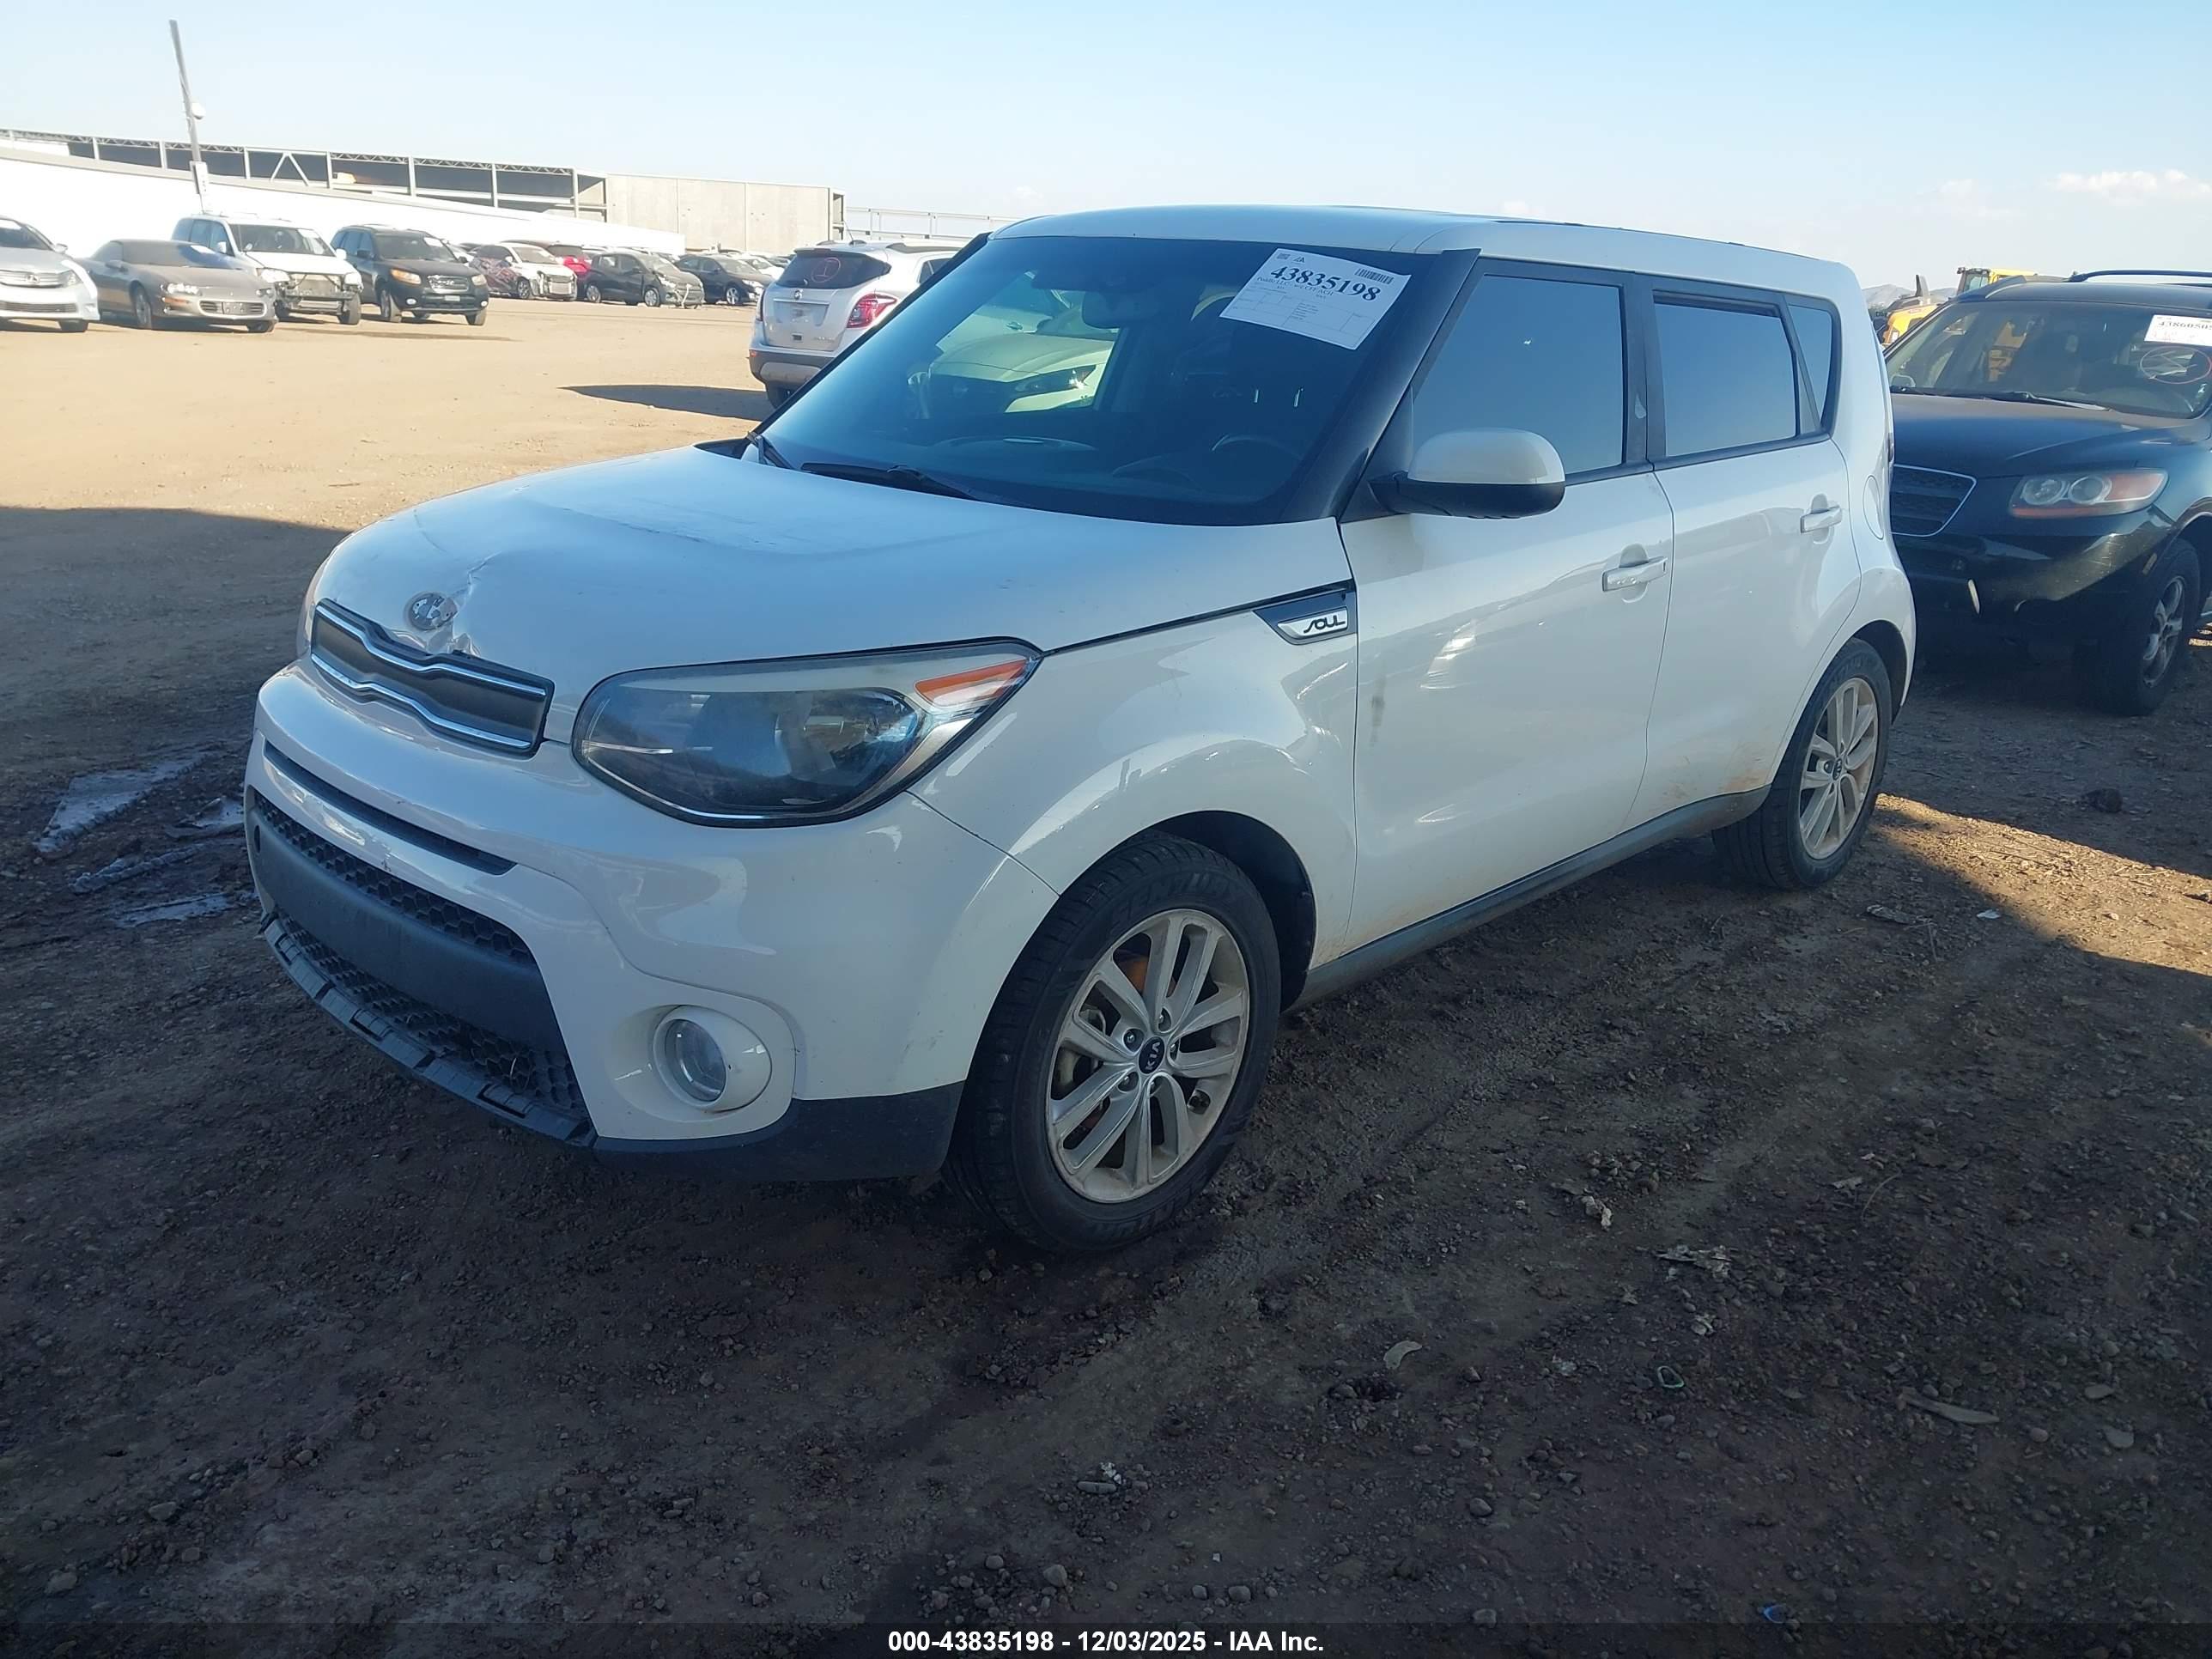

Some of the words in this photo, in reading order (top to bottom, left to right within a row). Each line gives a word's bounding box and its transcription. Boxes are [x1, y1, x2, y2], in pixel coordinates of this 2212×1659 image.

[1270, 265, 1381, 301] 43835198
[1304, 615, 1346, 634] SOUL
[1146, 1042, 1161, 1071] KIA
